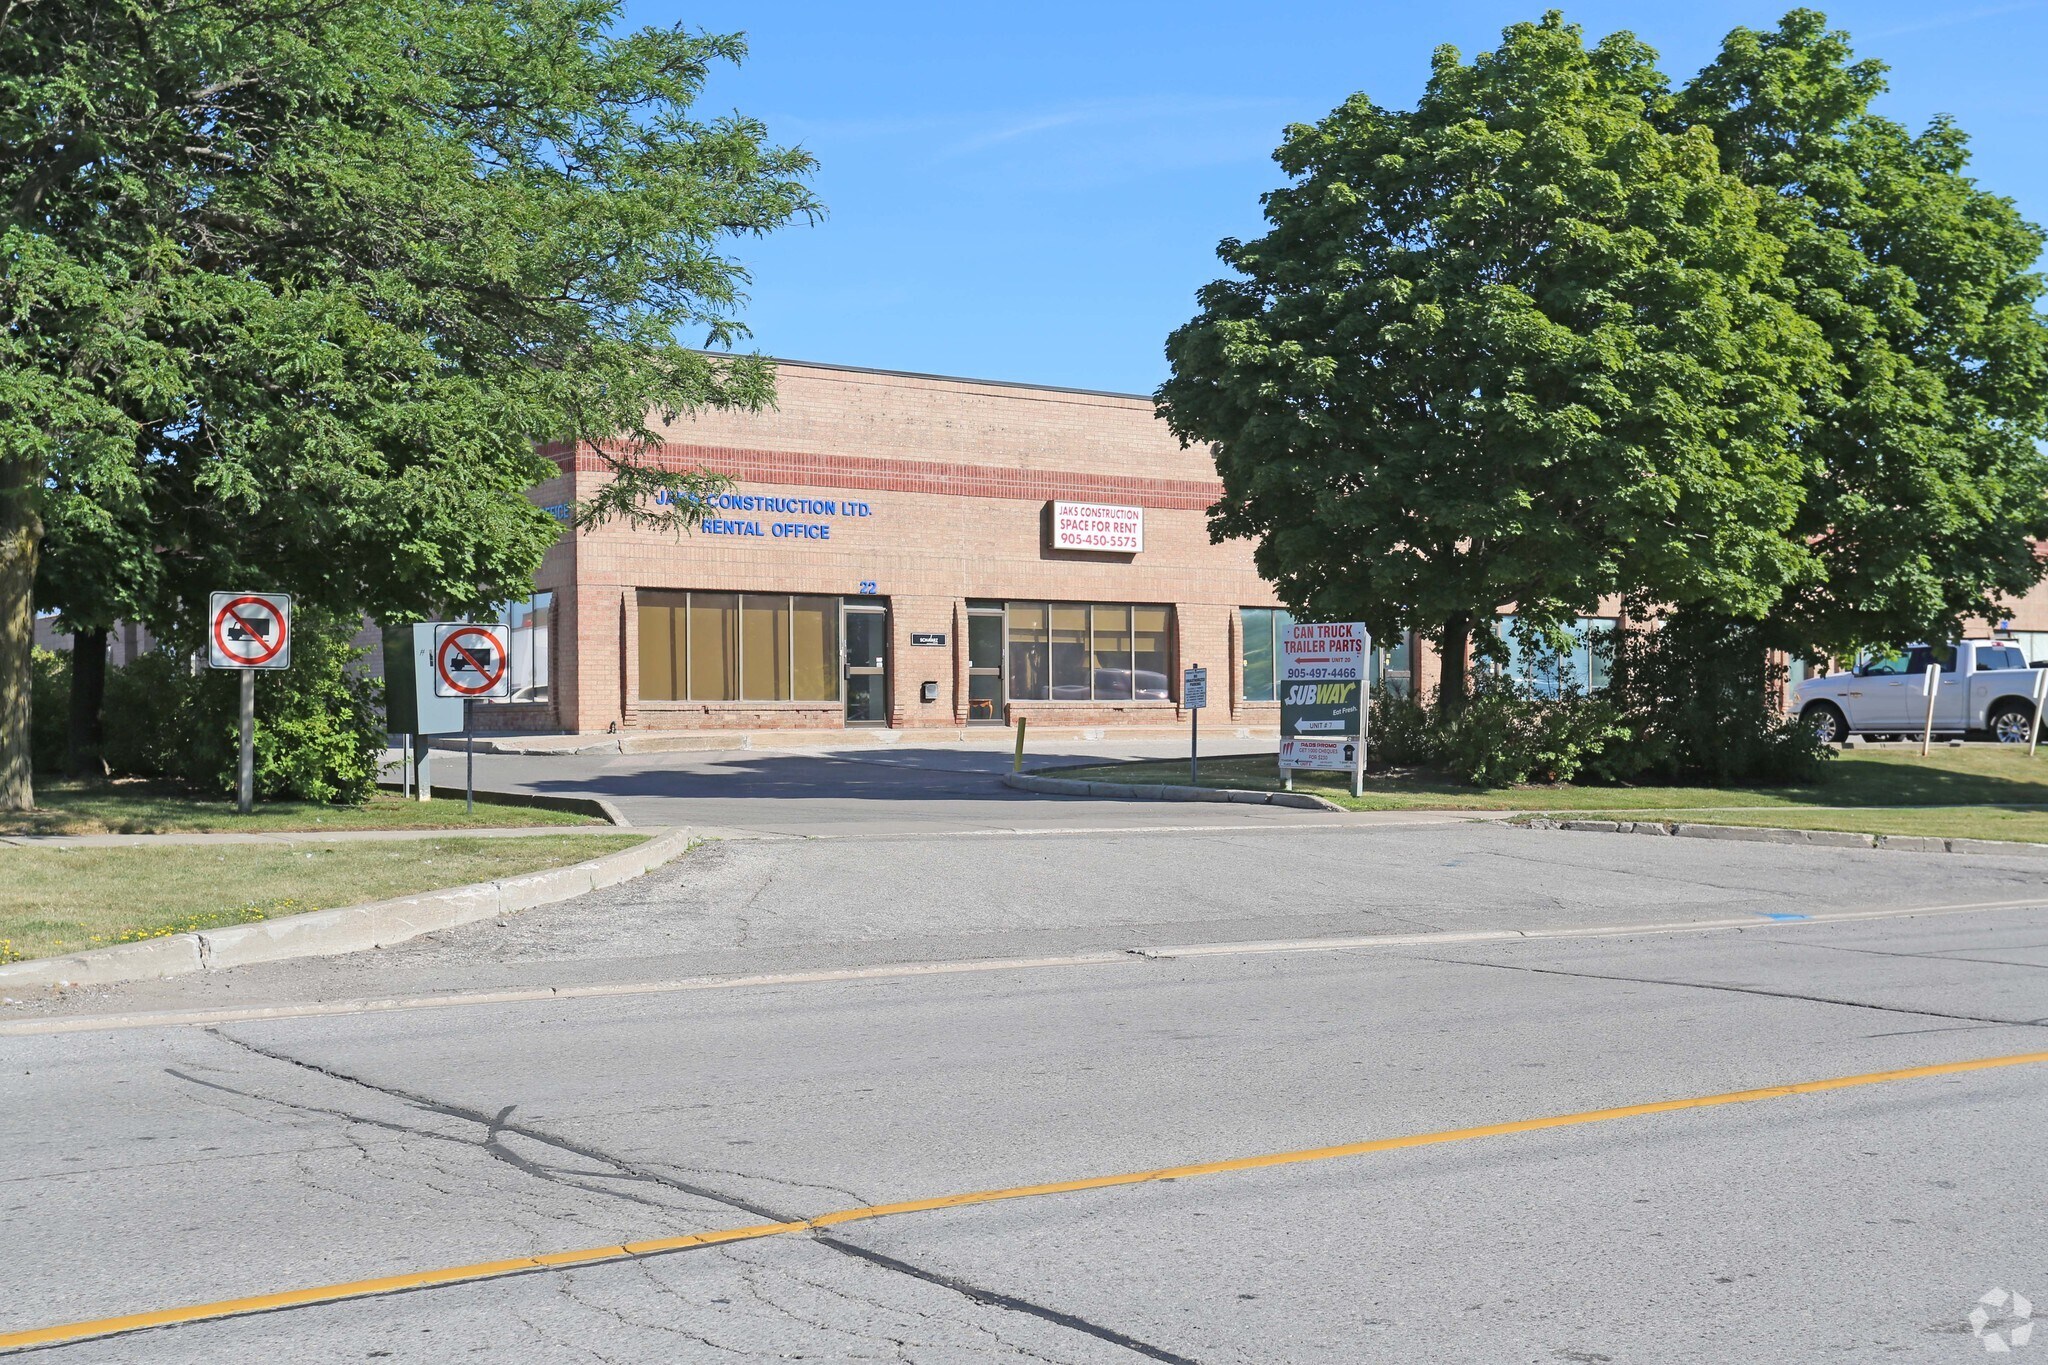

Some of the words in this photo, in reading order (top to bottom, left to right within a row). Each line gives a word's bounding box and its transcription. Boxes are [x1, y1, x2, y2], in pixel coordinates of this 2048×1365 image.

[707, 494, 836, 516] CONSTRUCTION
[842, 502, 872, 517] LTD.
[1059, 506, 1079, 516] JAKS
[1080, 507, 1139, 520] CONSTRUCTION
[702, 519, 765, 536] RENTAL
[772, 523, 830, 539] OFFICE
[1061, 519, 1089, 531] SPACE
[1092, 521, 1111, 532] FOR
[1114, 522, 1137, 533] RENT
[1061, 533, 1137, 547] 905-450-5575
[860, 581, 877, 594] 22
[1293, 626, 1314, 639] CAN
[1317, 625, 1353, 638] TRUCK
[1284, 640, 1326, 653] TRAILER
[1329, 639, 1362, 652] PARTS
[1285, 682, 1356, 706] SUBWAY
